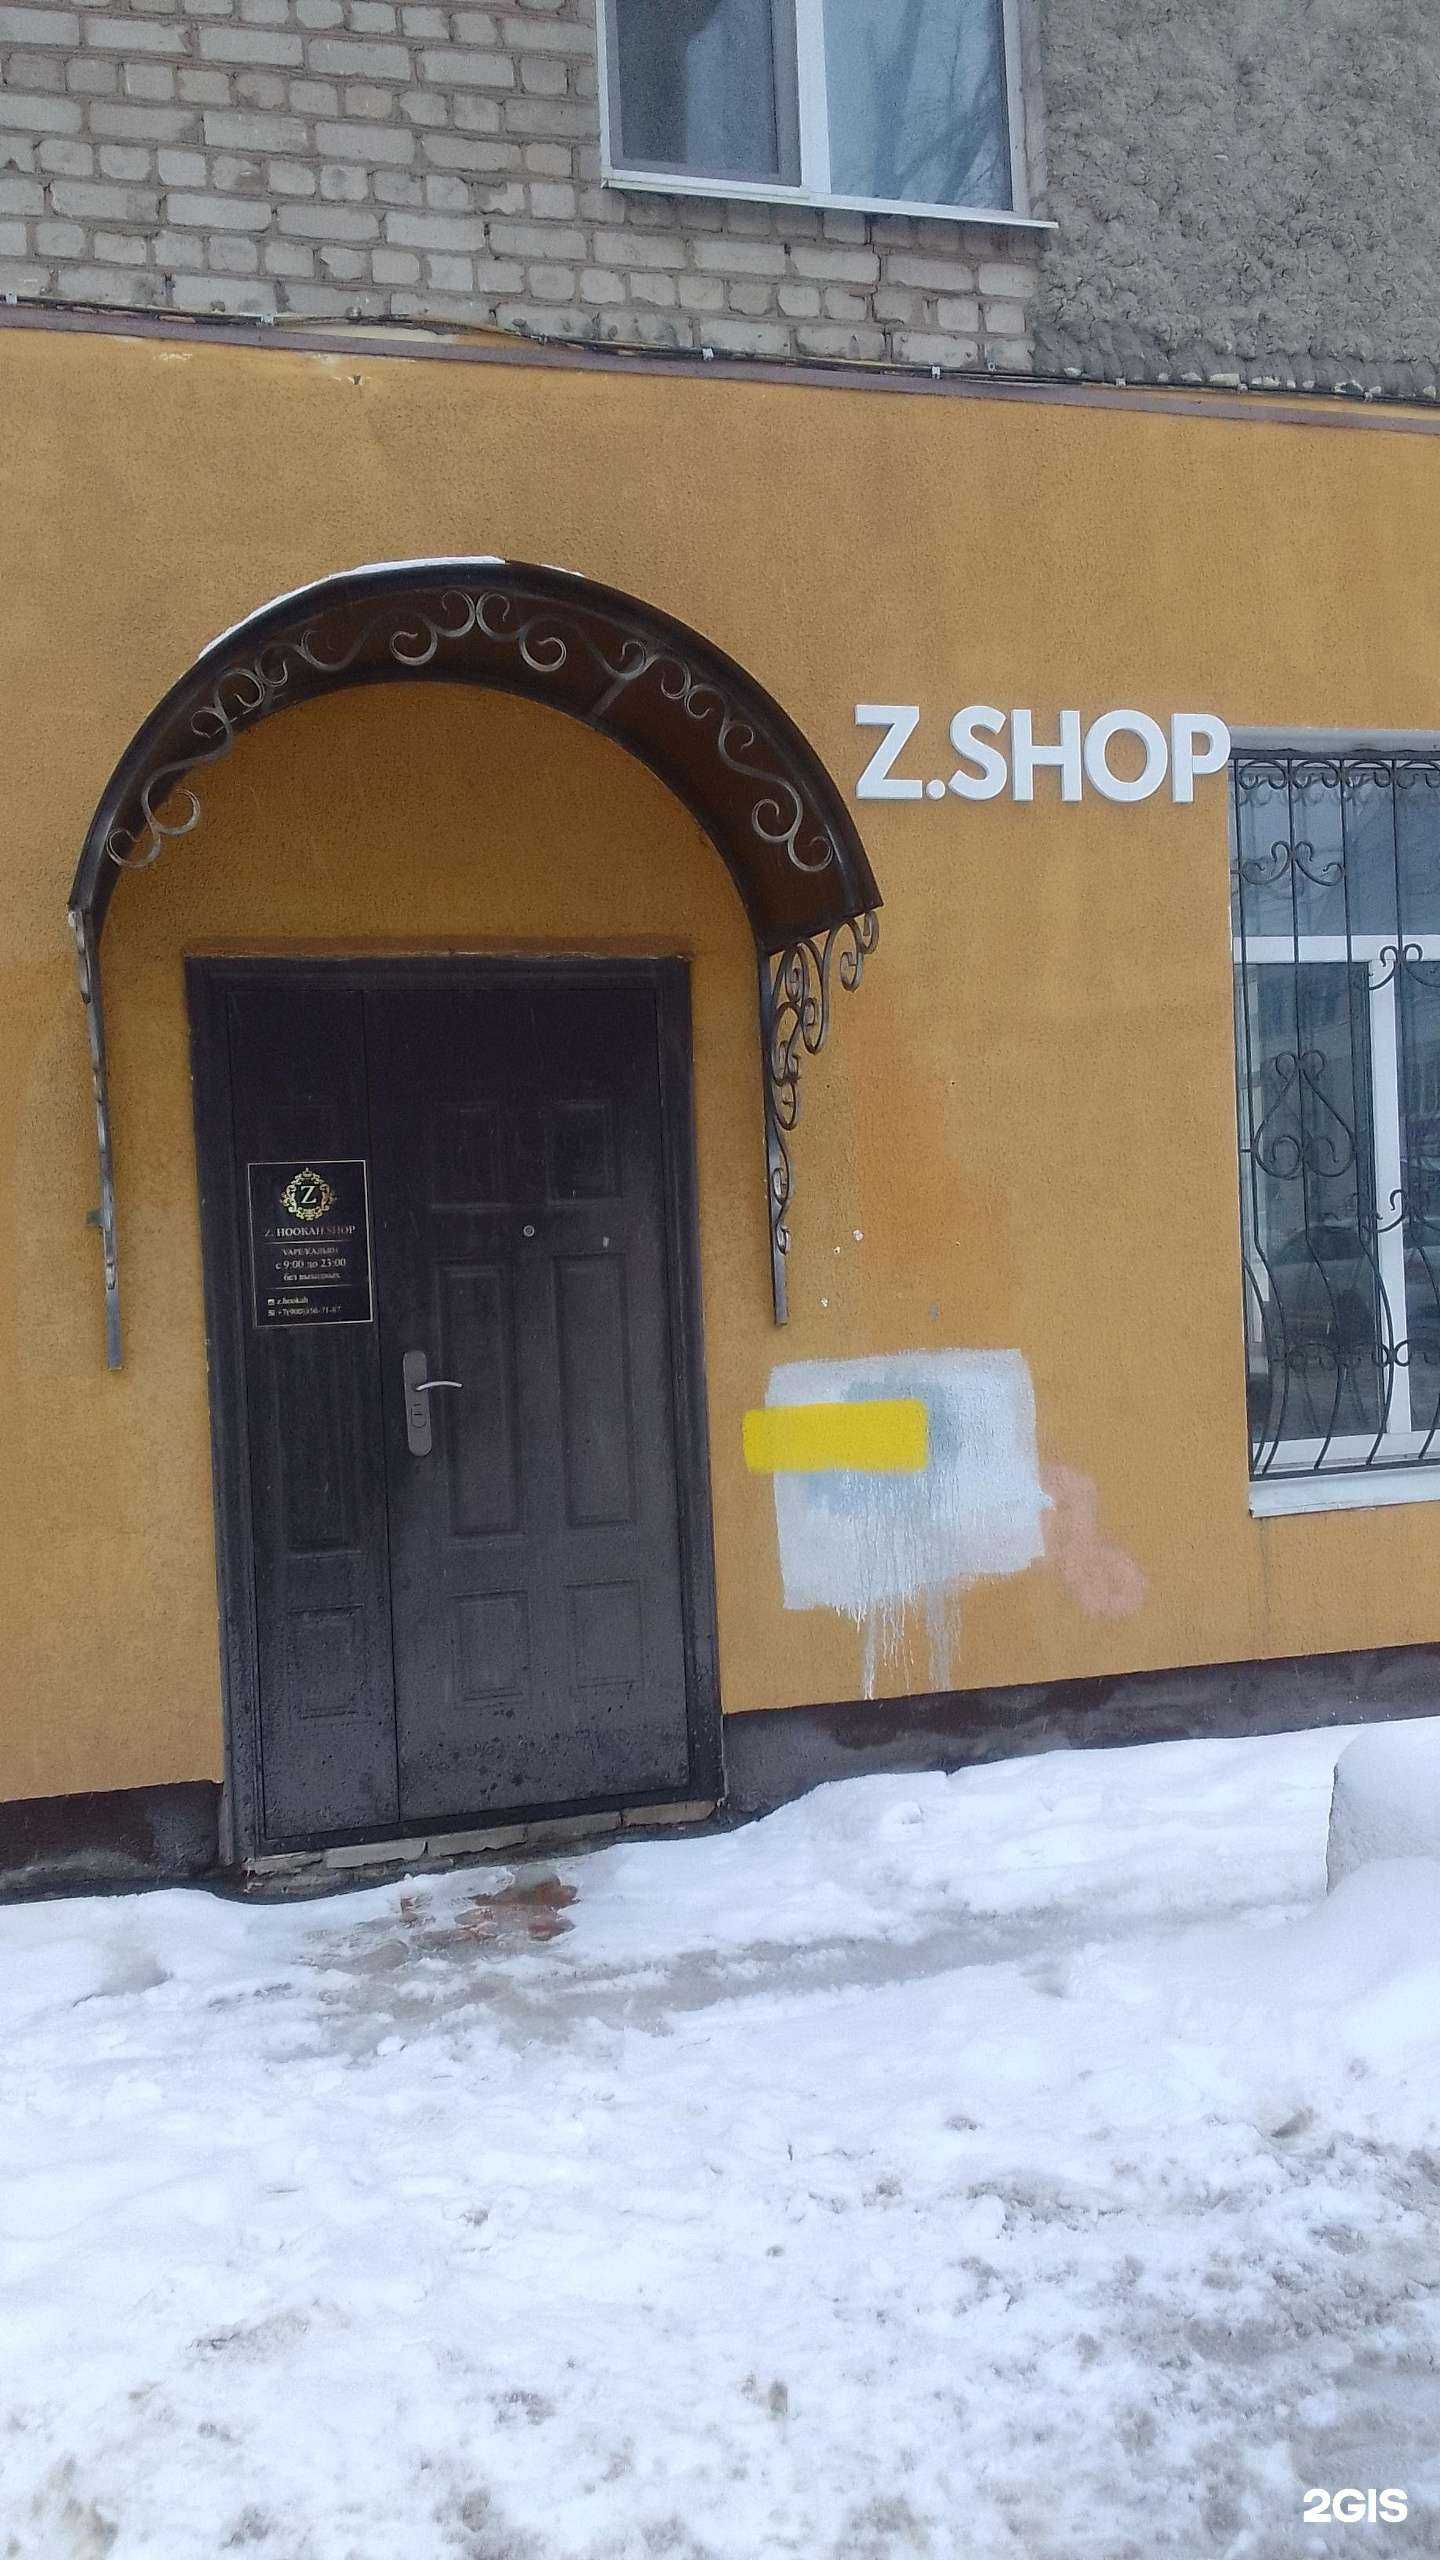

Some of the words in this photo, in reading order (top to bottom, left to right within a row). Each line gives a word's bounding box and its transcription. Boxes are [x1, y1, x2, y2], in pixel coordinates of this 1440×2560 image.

[855, 704, 1231, 803] Z.SHOP
[300, 1185, 317, 1204] Z
[276, 1226, 323, 1237] HOOKAH
[325, 1225, 356, 1236] SHOP
[283, 1259, 304, 1270] 9:00
[320, 1258, 346, 1268] 23:00
